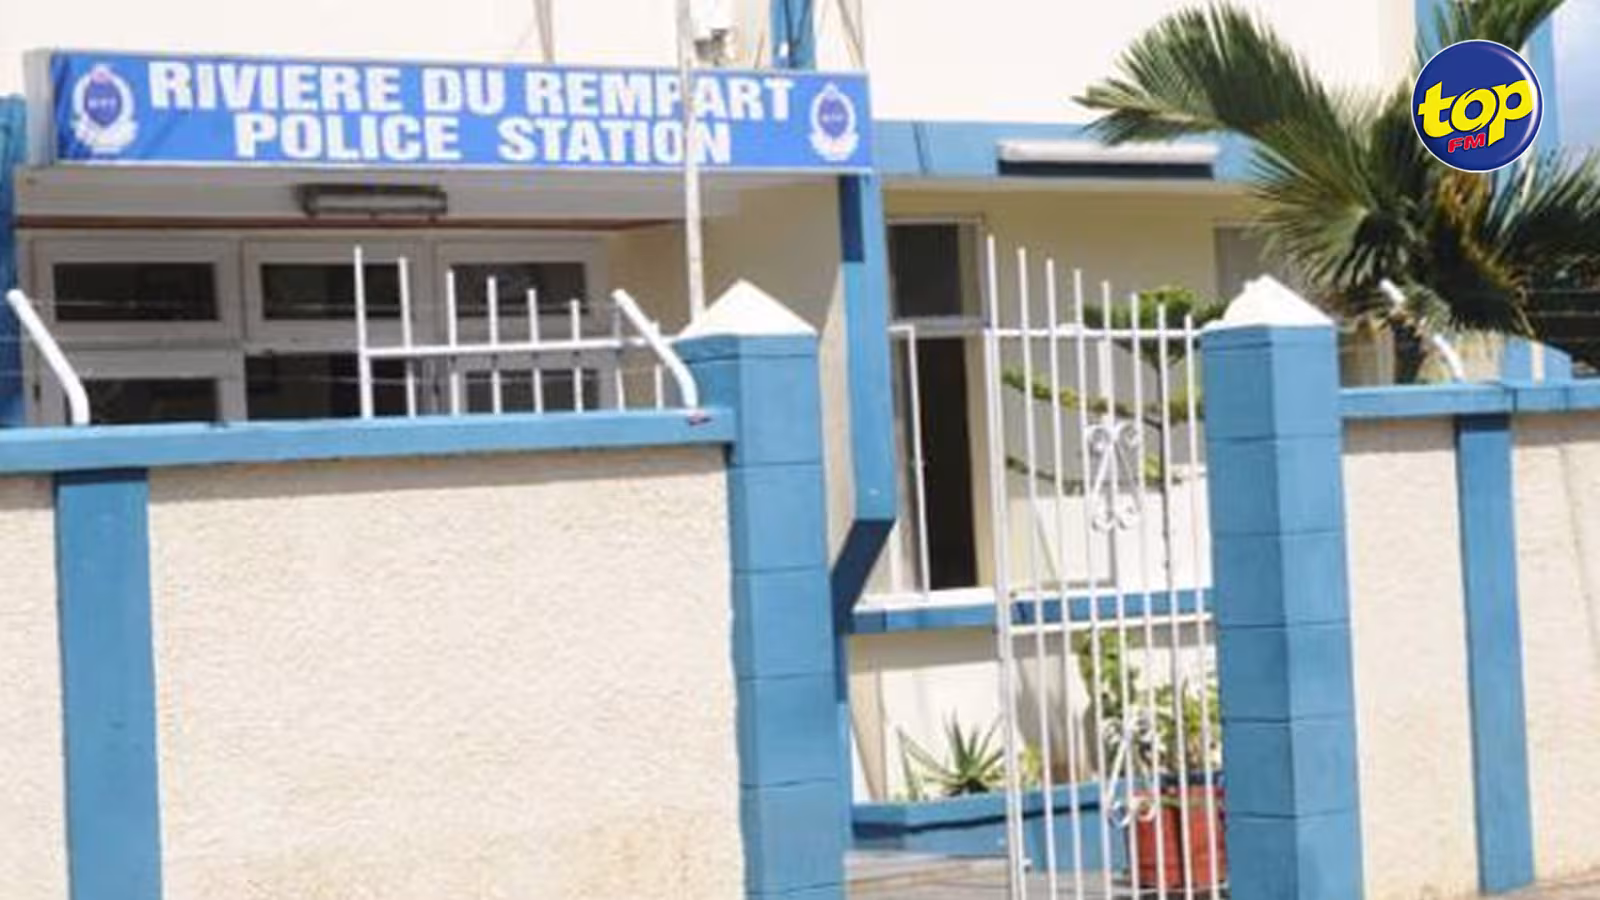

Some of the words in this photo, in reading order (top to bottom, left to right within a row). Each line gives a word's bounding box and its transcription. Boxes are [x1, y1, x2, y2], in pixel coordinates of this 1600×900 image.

[147, 61, 402, 111] RIVIERE
[422, 68, 506, 115] DU
[525, 69, 794, 121] REMPART
[234, 114, 462, 161] POLICE
[497, 116, 732, 164] STATION
